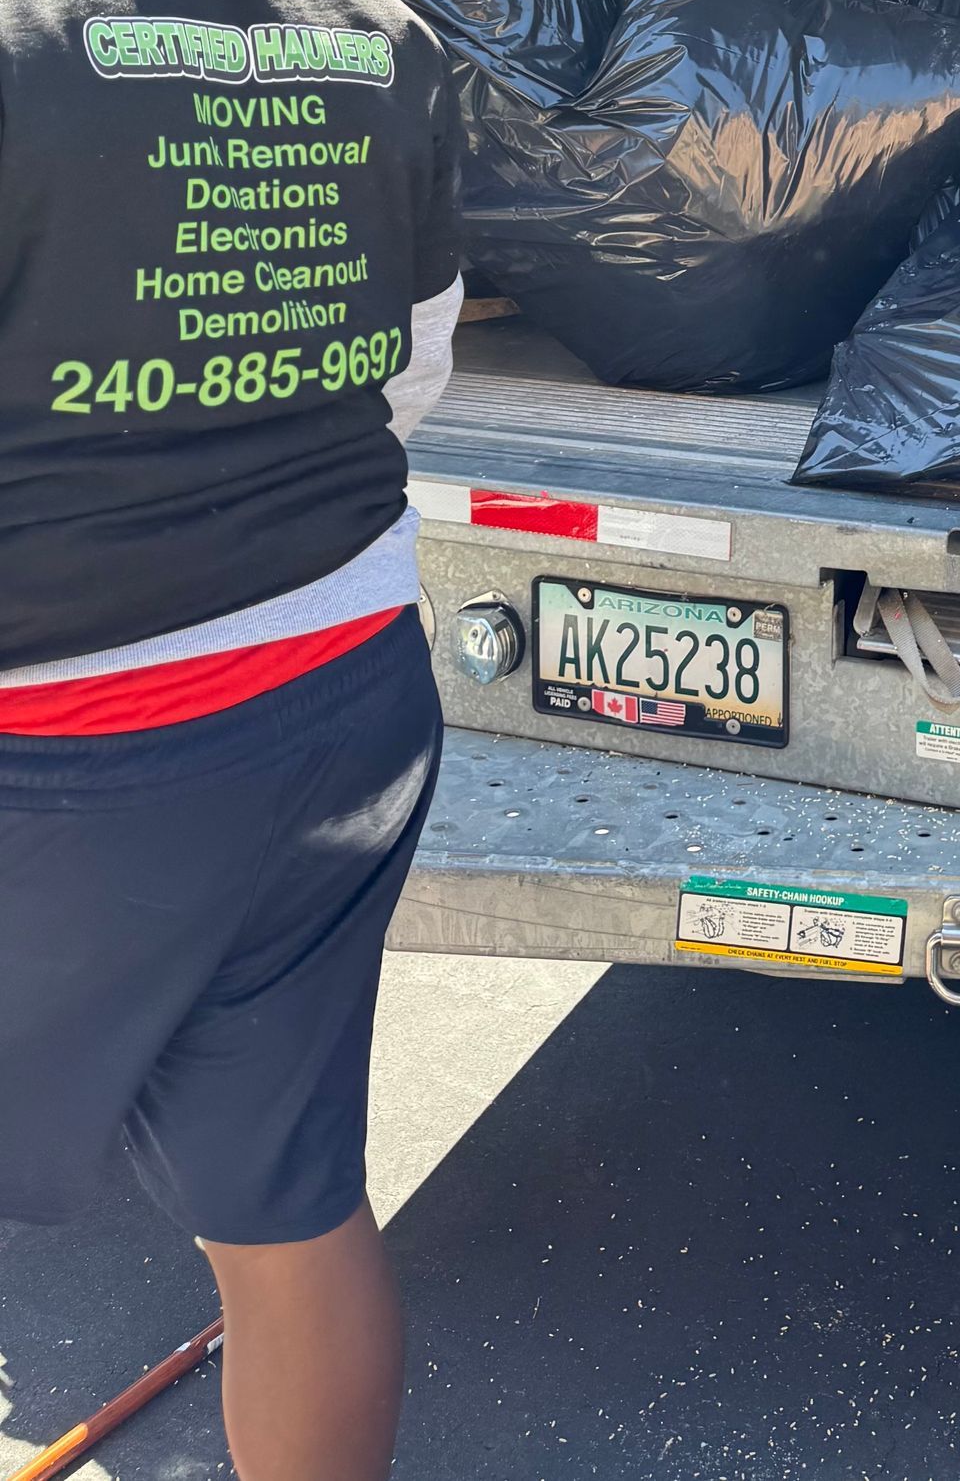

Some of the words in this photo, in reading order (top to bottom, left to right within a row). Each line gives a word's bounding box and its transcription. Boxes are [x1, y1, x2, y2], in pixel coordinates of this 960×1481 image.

[88, 21, 248, 73] CERTIFIED
[253, 27, 391, 77] HAULERS
[193, 92, 327, 128] MOVING
[147, 135, 224, 169] Junk
[227, 135, 371, 169] Removal
[186, 178, 340, 211] Donations
[175, 218, 348, 254] Electronics
[135, 267, 245, 301] Home
[254, 252, 368, 293] Cleanout
[178, 300, 347, 341] Demolition
[50, 326, 402, 415] 240-885-9697
[599, 596, 724, 624] ARIZONA
[755, 621, 781, 634] PERM
[558, 613, 760, 705] AK25238
[550, 696, 571, 708] PAID
[706, 707, 772, 726] APPORTIONED
[746, 887, 808, 903] SAFETY-CHAIN
[809, 894, 845, 906] HOOKUP
[728, 948, 745, 956] CHECK
